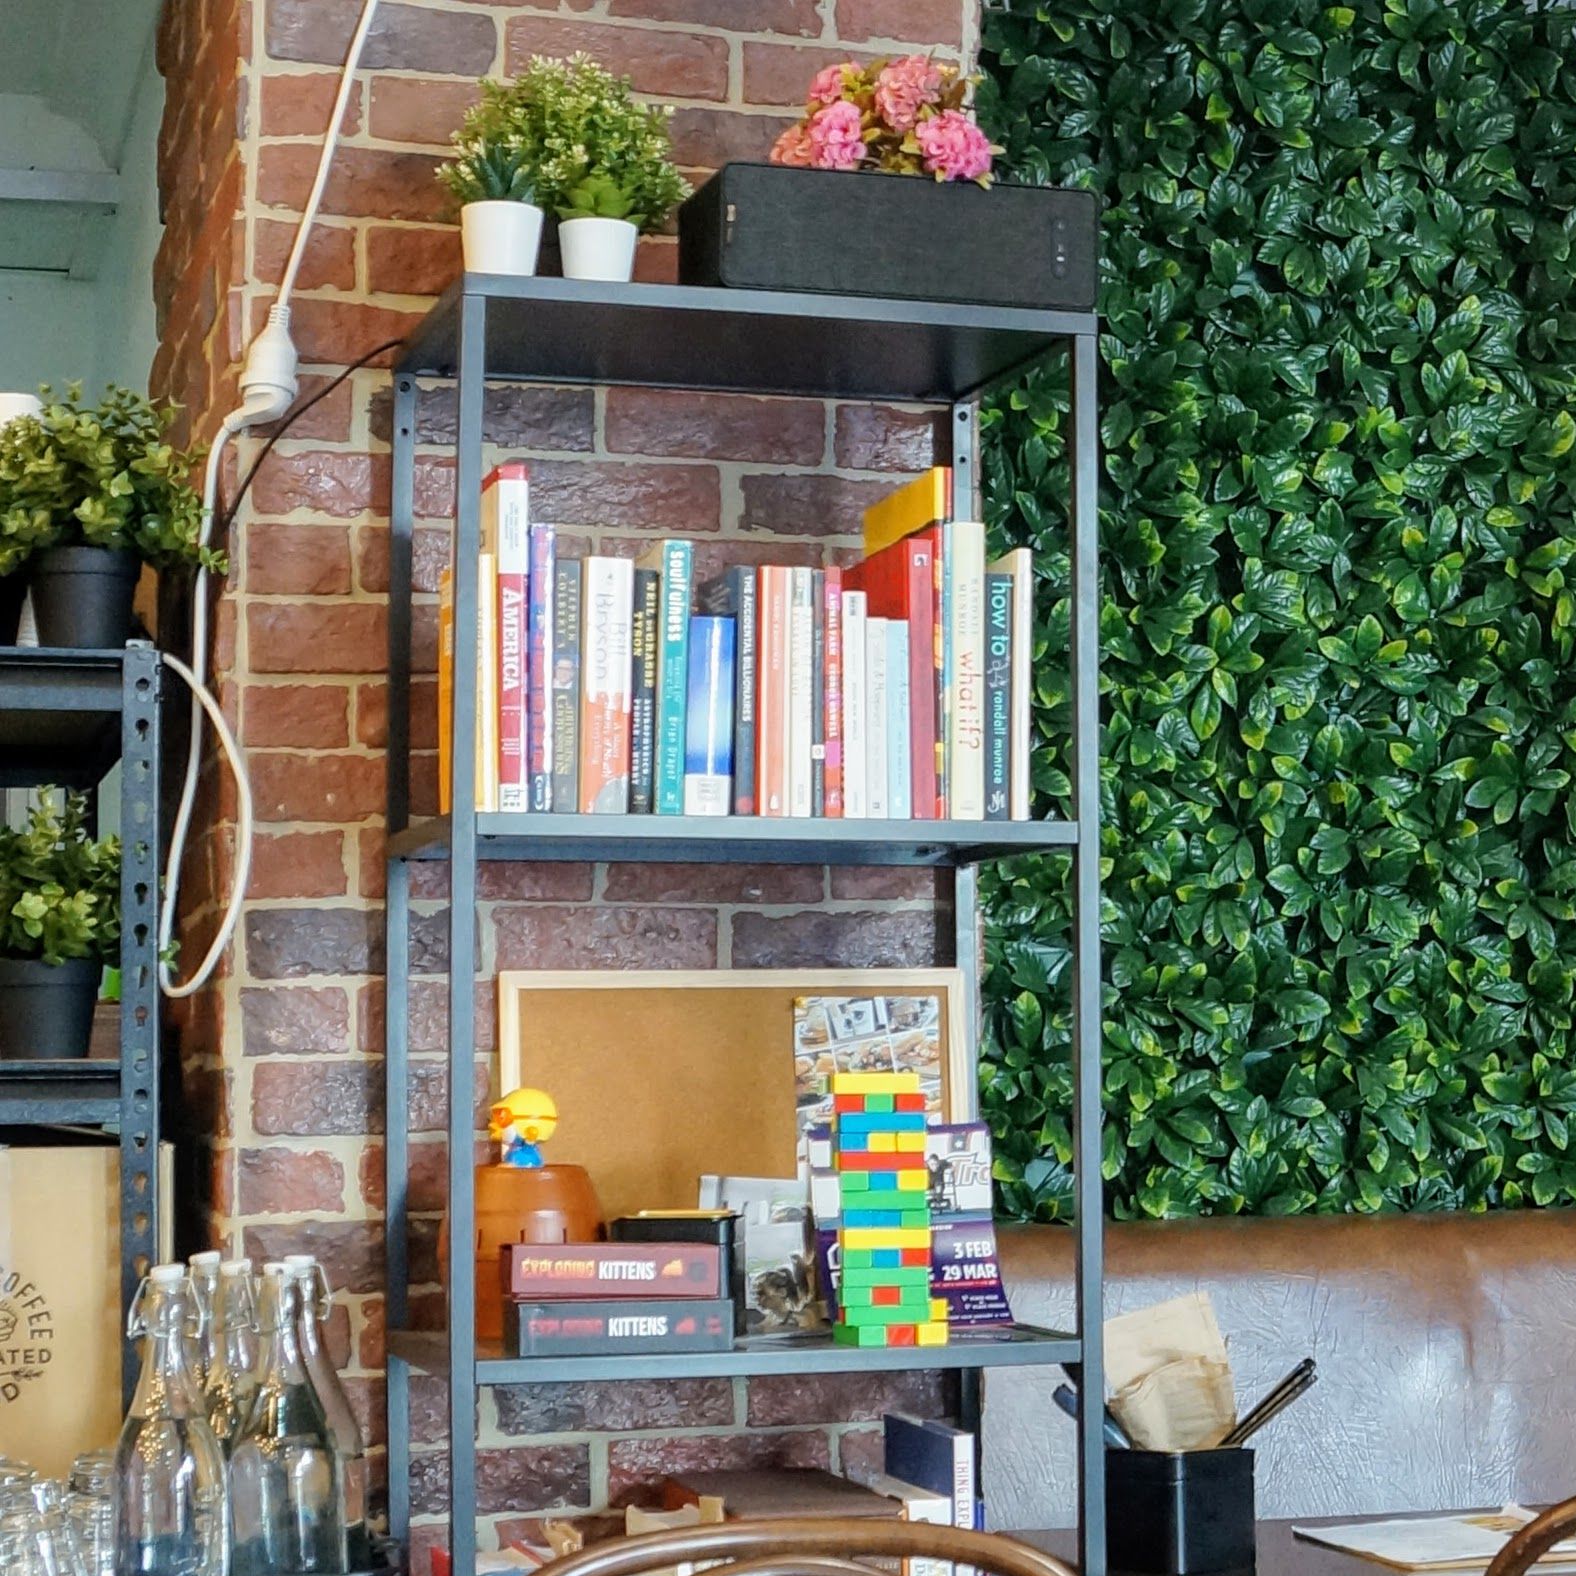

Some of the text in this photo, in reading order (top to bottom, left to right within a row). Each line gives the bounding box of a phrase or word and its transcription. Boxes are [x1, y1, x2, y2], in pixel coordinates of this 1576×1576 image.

[646, 582, 657, 616] NEIL
[667, 551, 687, 641] soulfulness
[743, 575, 753, 593] THE
[502, 587, 524, 692] AMERICA
[594, 593, 615, 680] Bryson
[609, 622, 628, 655] Bill
[633, 611, 643, 657] TYSON
[743, 596, 753, 654] ACCIDENTAL
[828, 593, 837, 656] ANIMAL FARM
[990, 582, 1012, 656] how to
[742, 656, 752, 721] BILLIONAIRES
[958, 652, 982, 749] what if?
[667, 717, 680, 743] Brian
[828, 701, 837, 737] ORWELL
[993, 690, 1009, 784] randall munroe
[599, 1260, 656, 1281] KITTENS
[942, 1263, 998, 1281] 29 MAR
[954, 1241, 993, 1259] 3 FEB
[0, 1265, 54, 1341] OFFEE
[608, 1316, 668, 1337] KITTENS
[957, 1461, 970, 1494] THING
